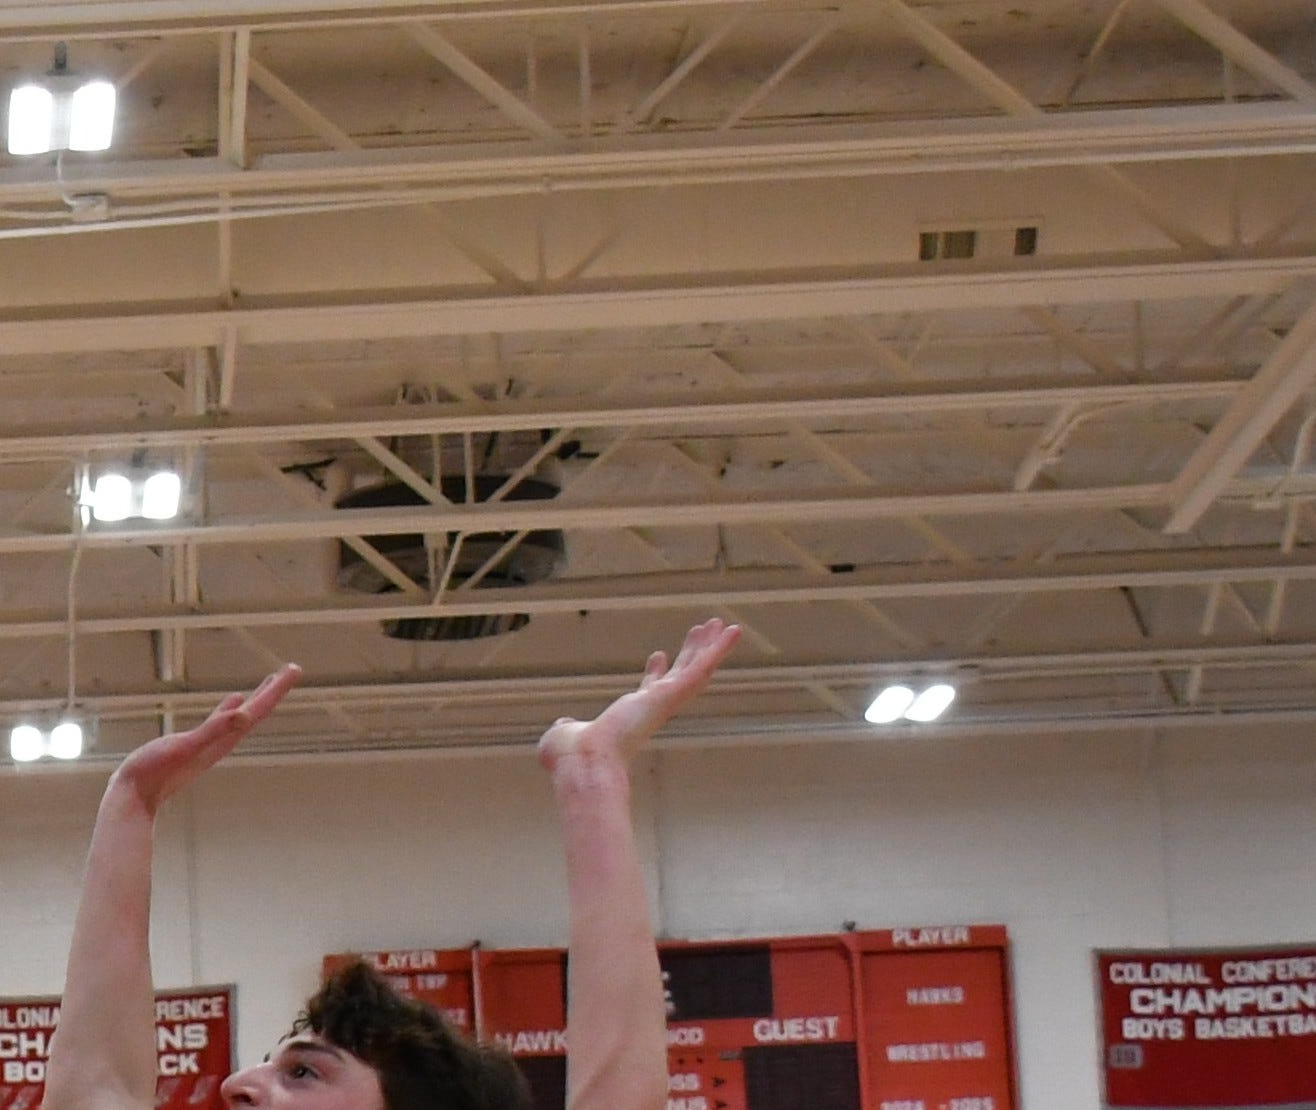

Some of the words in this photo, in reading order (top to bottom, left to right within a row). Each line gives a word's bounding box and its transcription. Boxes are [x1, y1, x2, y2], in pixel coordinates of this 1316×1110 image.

[892, 927, 971, 945] PLAYER
[1109, 962, 1212, 985] COLONIAL
[156, 996, 225, 1019] RENCE
[1129, 983, 1316, 1015] CHAMPION
[753, 1016, 838, 1042] GUEST
[1122, 1017, 1185, 1040] BOYS
[1195, 1014, 1316, 1040] BASKETBA
[886, 1041, 985, 1061] WRESTLING
